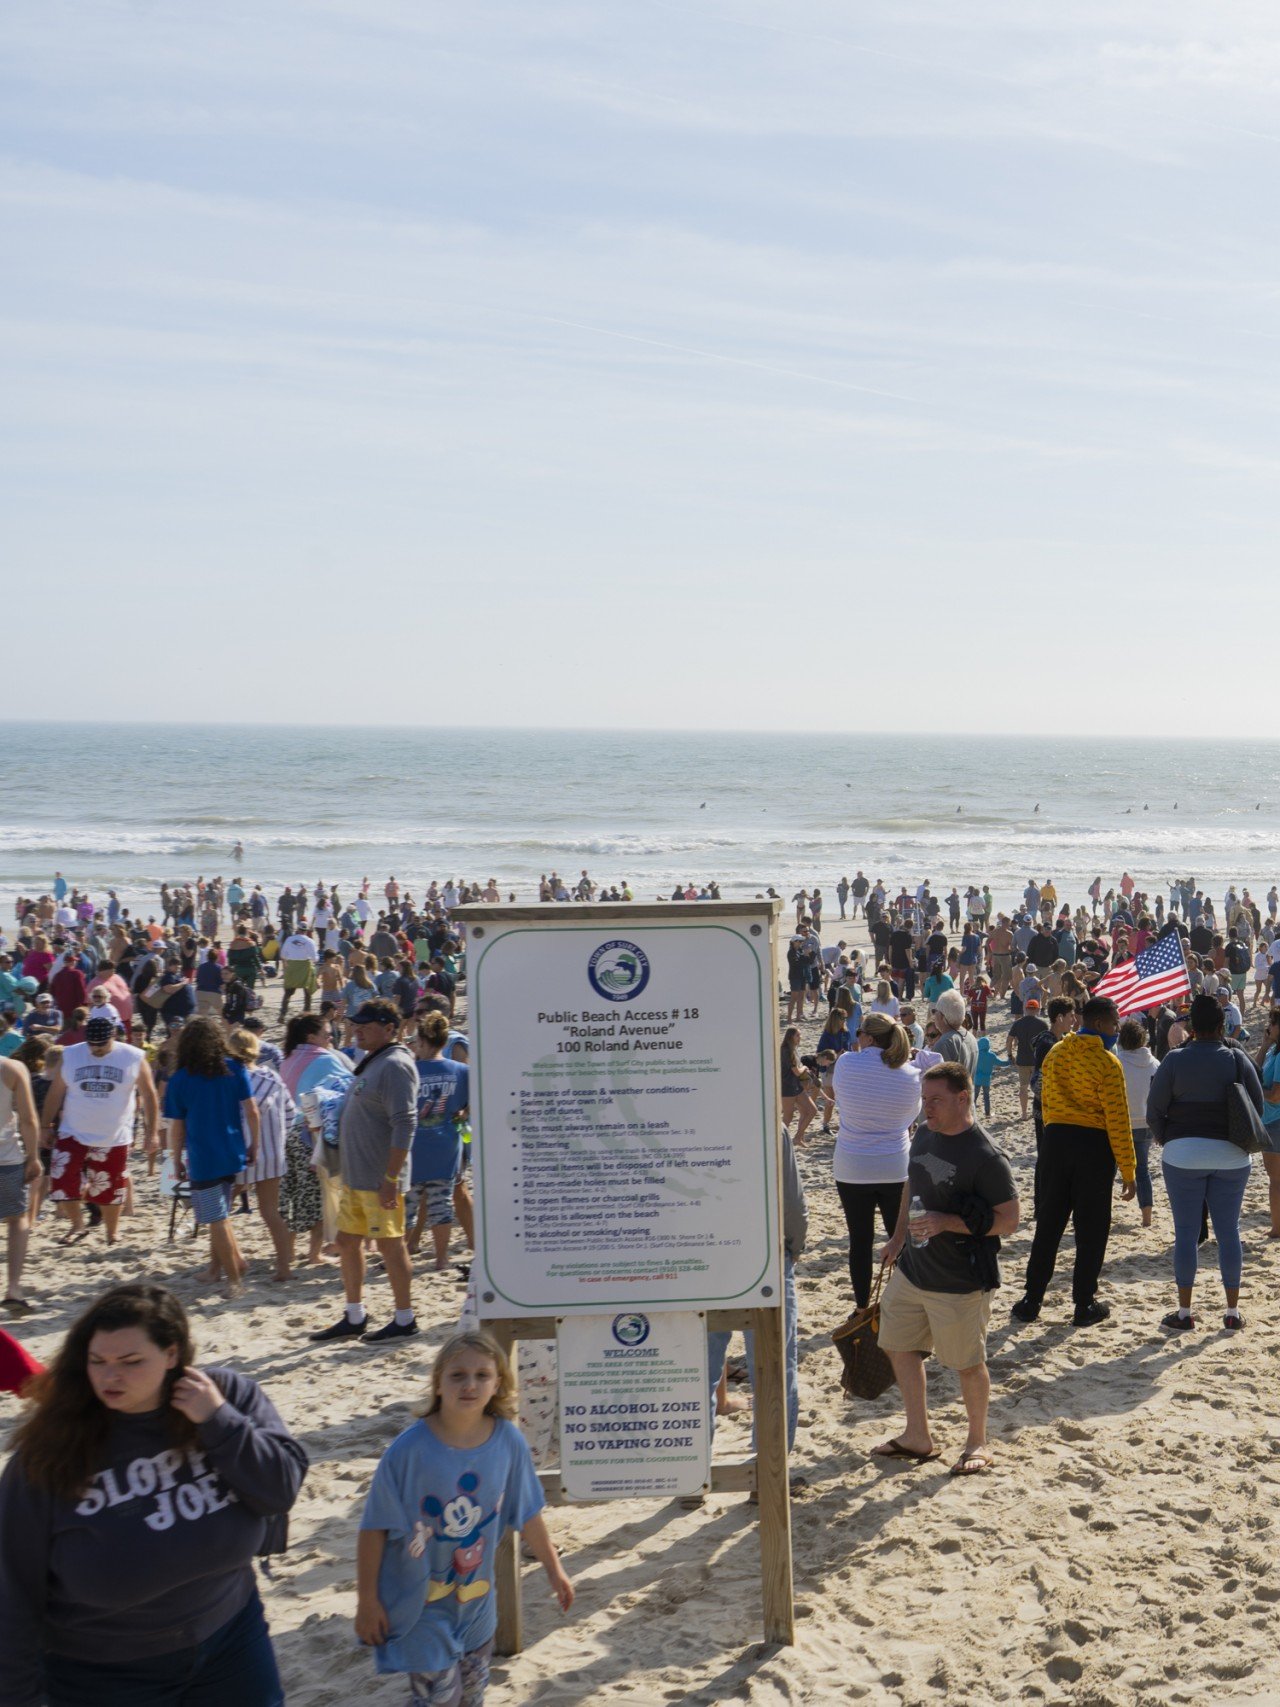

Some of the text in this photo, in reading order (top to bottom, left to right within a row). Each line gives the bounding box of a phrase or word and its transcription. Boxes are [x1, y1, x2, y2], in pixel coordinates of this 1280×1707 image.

[589, 948, 606, 967] TOWN
[617, 942, 637, 954] SURF
[635, 950, 648, 967] CITY
[975, 989, 982, 1001] 7
[537, 1008, 699, 1023] Public Beach Access # 18
[556, 1038, 683, 1053] 100 Roland Avenue
[608, 1087, 644, 1096] weather
[646, 1085, 690, 1094] conditions
[544, 1107, 557, 1115] off
[564, 1124, 594, 1132] always
[647, 1121, 670, 1129] leash
[536, 1141, 570, 1149] littering
[522, 1164, 560, 1172] Personal
[616, 1161, 653, 1170] disposed
[691, 1159, 731, 1168] overnight
[644, 1176, 666, 1184] filled
[602, 1194, 638, 1202] charcoal
[640, 1193, 660, 1202] grills
[538, 1214, 559, 1222] glass
[569, 1212, 603, 1220] allowed
[634, 1210, 660, 1218] beach
[539, 1230, 570, 1238] alcohol
[582, 1226, 651, 1237] smoking/vaping
[604, 1348, 659, 1358] WELCOME
[564, 1402, 701, 1416] NO ALCOHOL ZONE
[564, 1419, 701, 1433] NO SMOKING ZONE
[573, 1437, 693, 1451] NO VAPING ZONE
